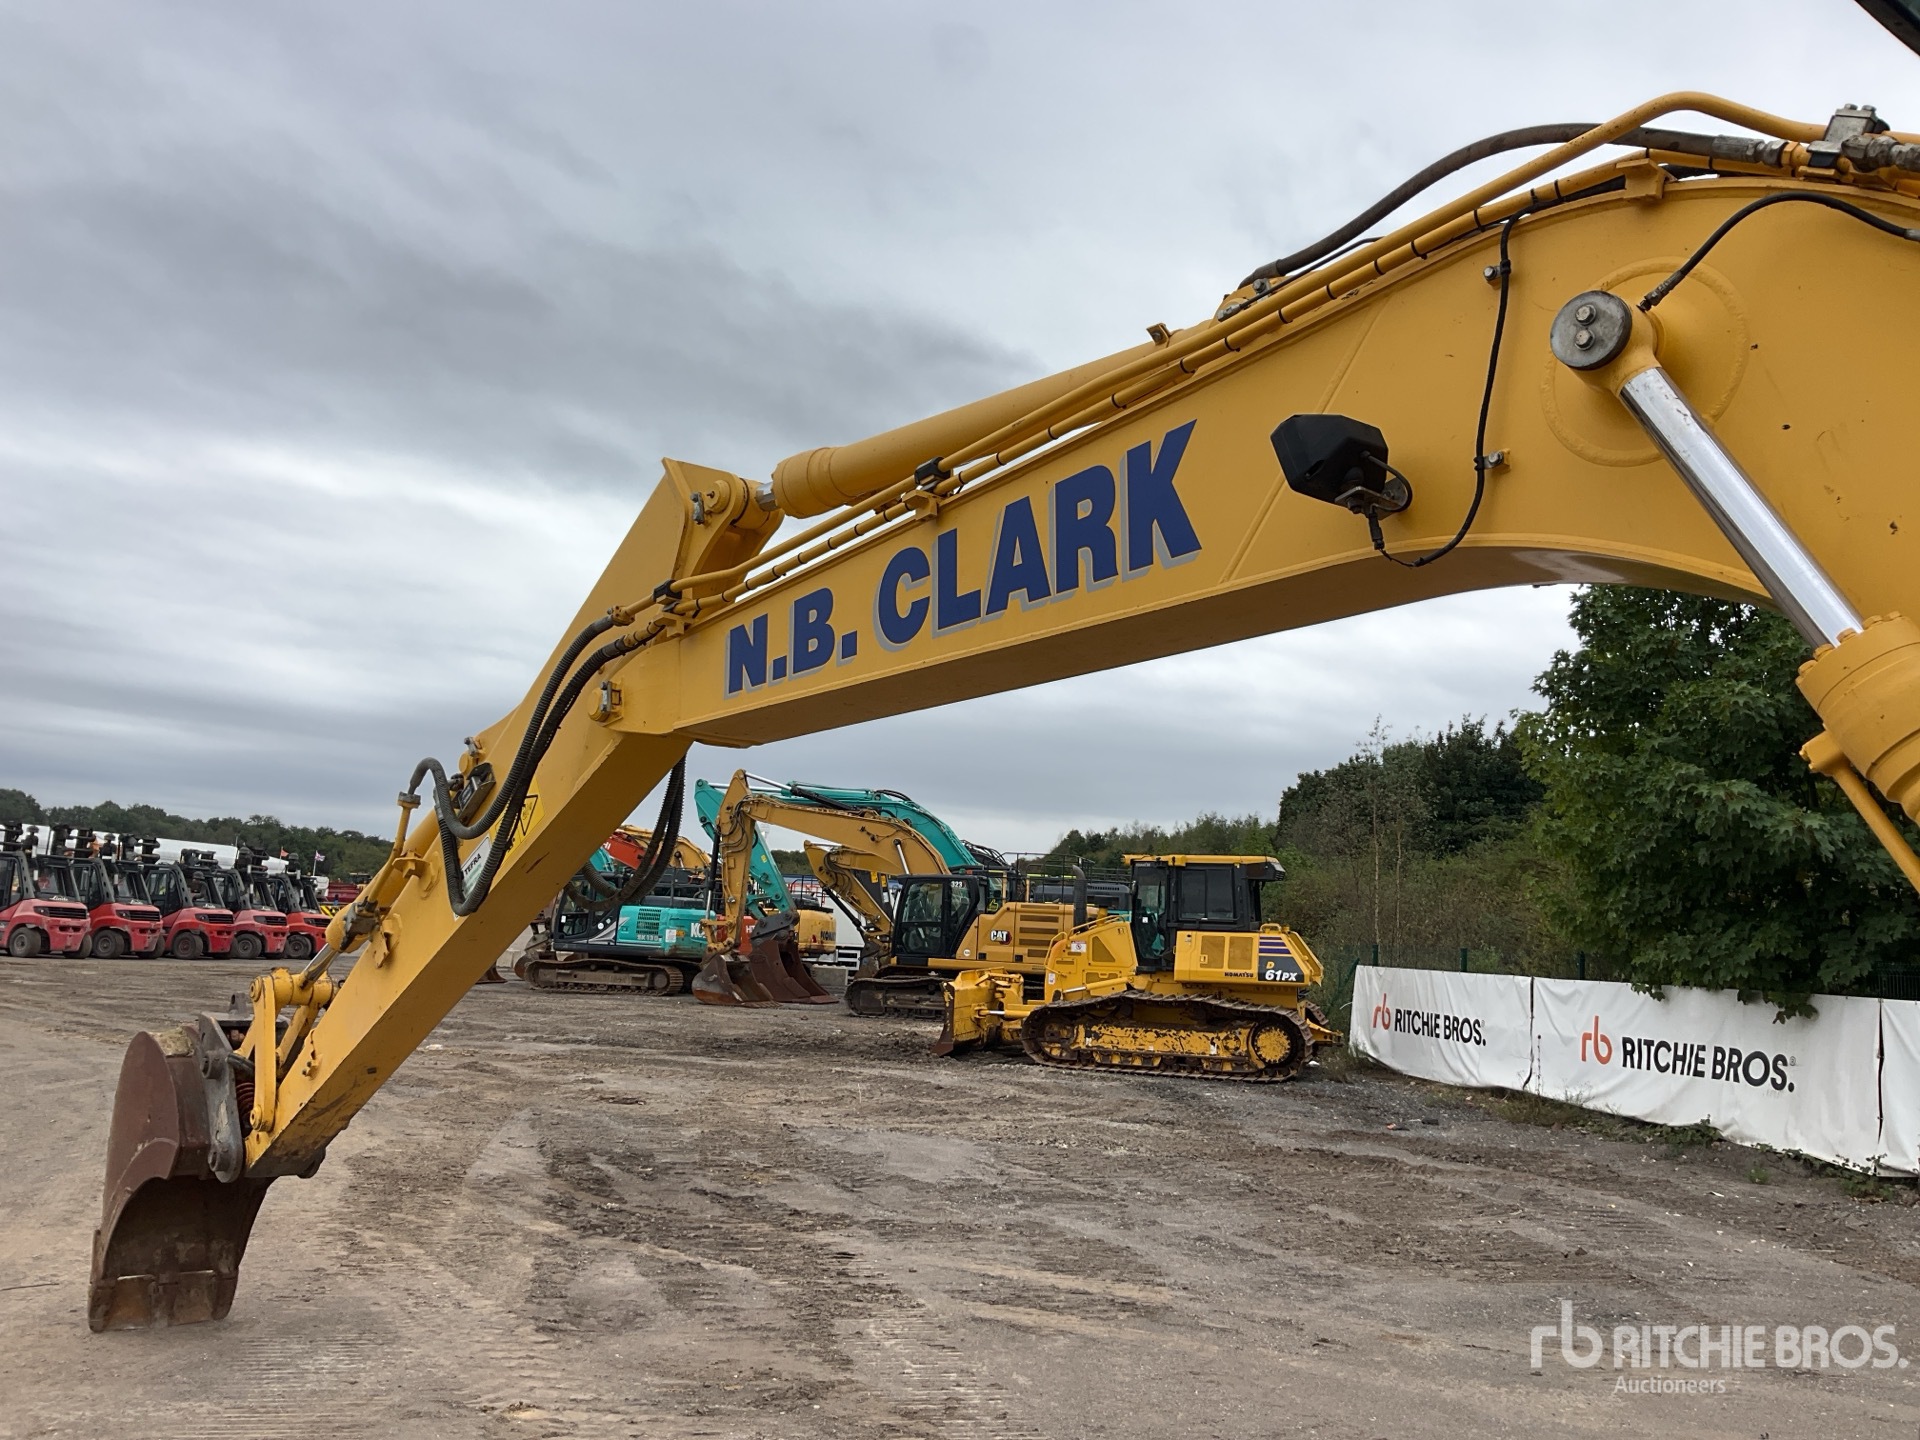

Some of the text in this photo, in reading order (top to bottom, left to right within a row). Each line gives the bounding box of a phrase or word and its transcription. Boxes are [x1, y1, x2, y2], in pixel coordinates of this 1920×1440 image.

[726, 418, 1202, 697] N.B. CLARK
[990, 930, 1008, 942] CAT
[1265, 969, 1297, 981] 61PX
[1266, 961, 1275, 969] D
[1394, 1008, 1440, 1039] RITCHIE
[1621, 1036, 1706, 1078] RITCHIE
